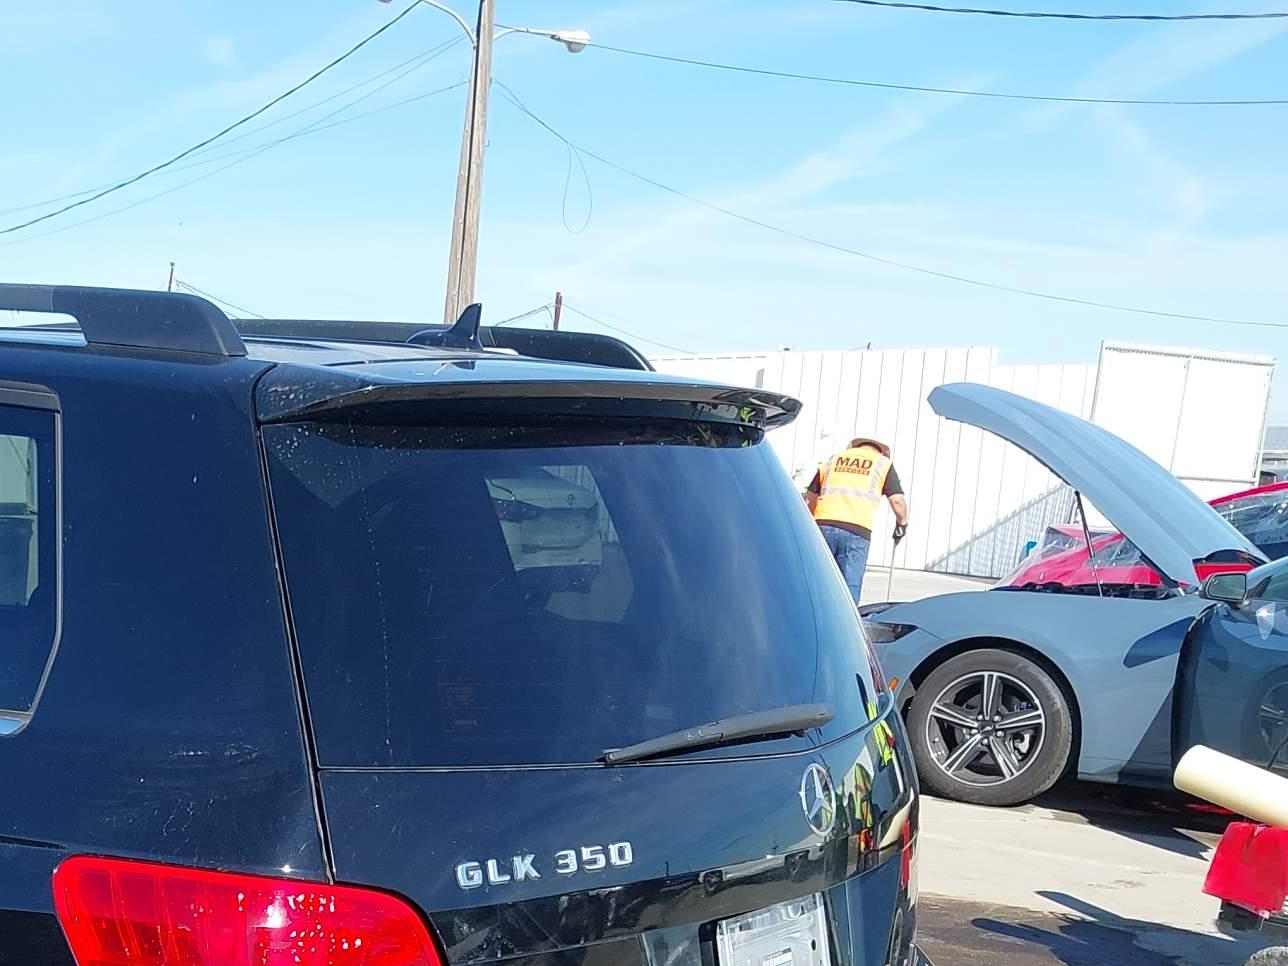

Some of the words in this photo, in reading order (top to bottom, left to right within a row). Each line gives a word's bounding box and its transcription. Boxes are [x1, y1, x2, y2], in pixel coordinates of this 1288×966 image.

[835, 456, 873, 469] MAD
[456, 854, 541, 889] GLK
[554, 841, 633, 876] 350
